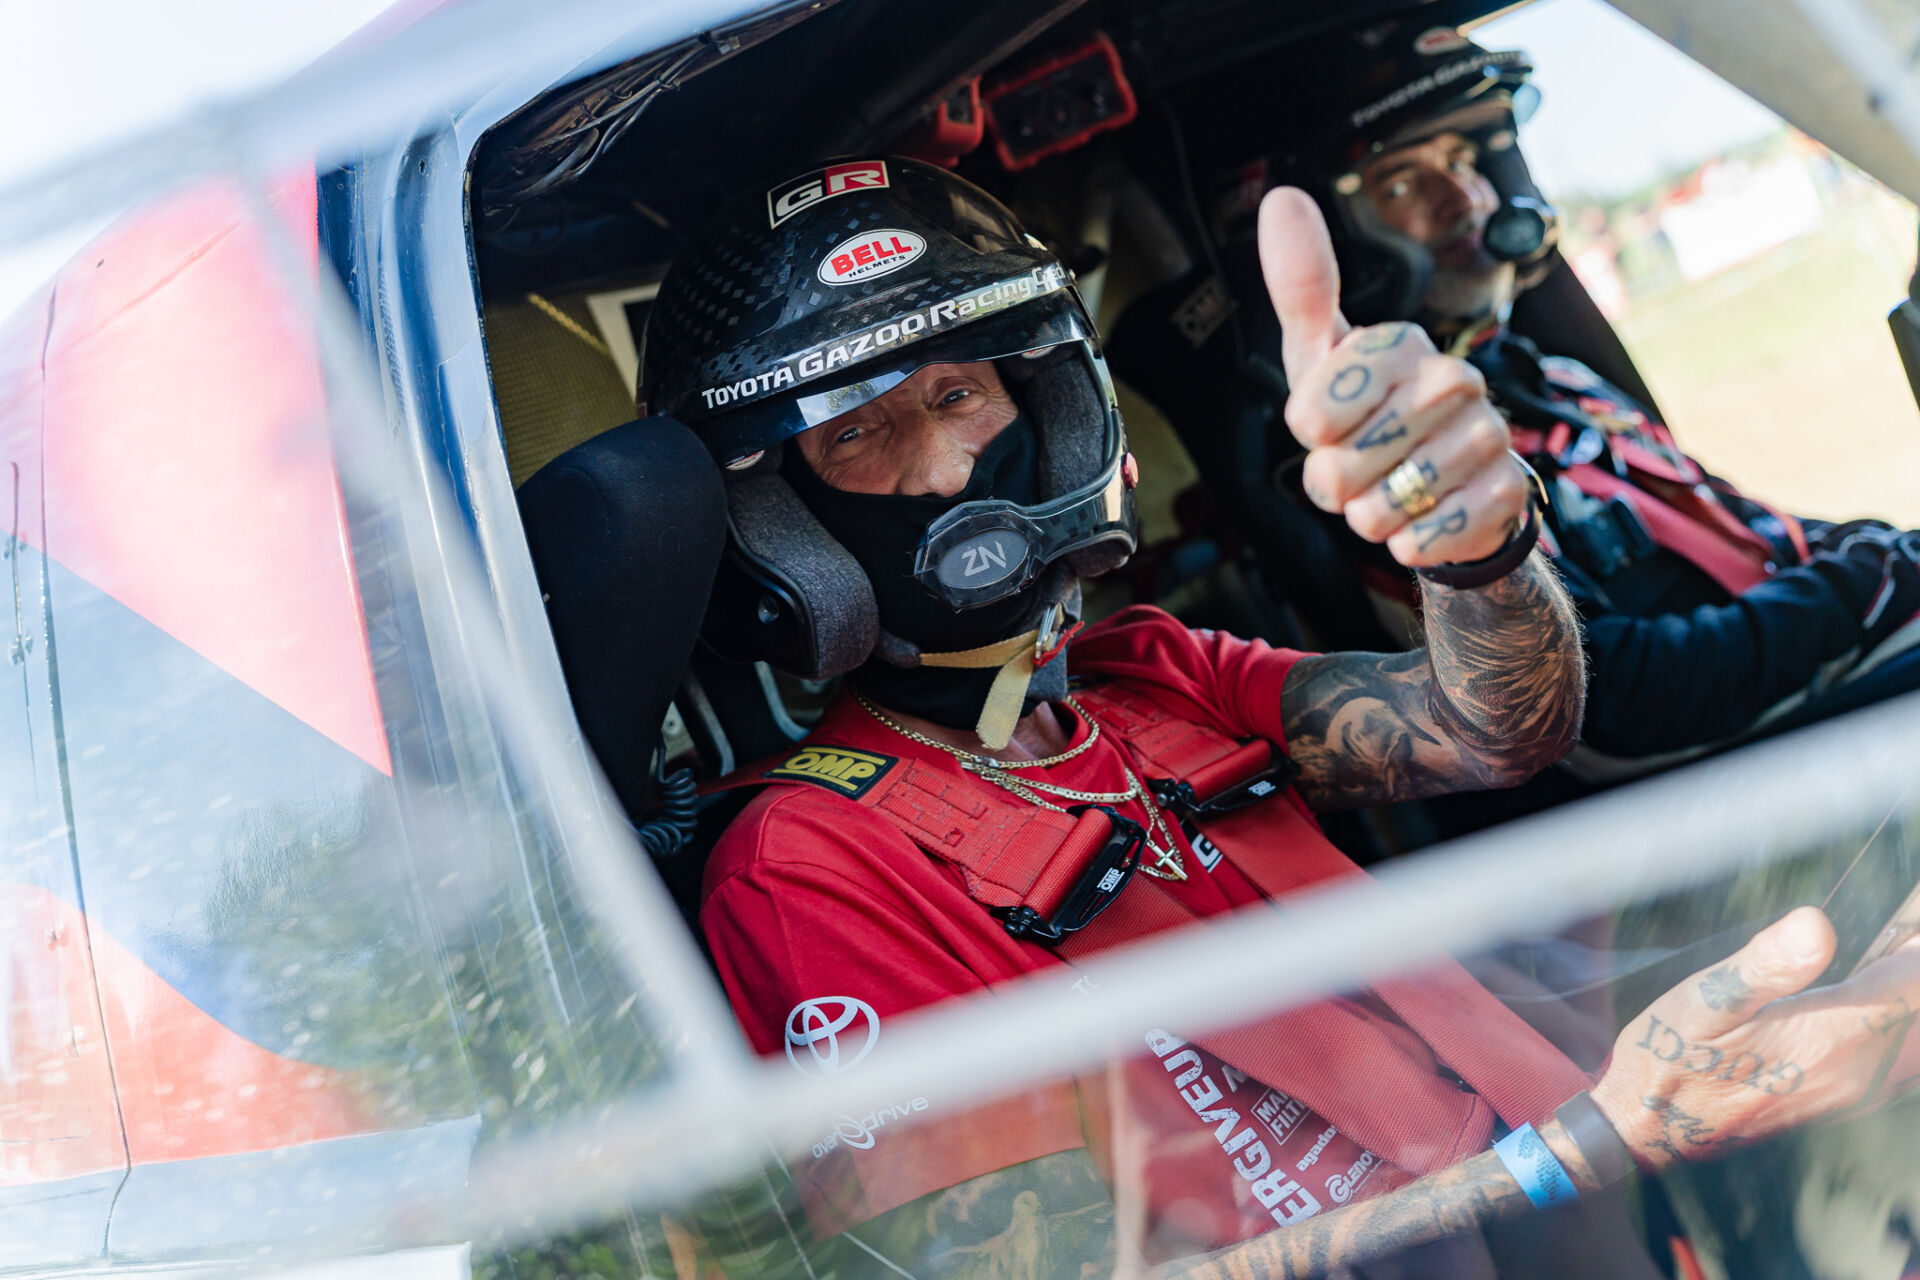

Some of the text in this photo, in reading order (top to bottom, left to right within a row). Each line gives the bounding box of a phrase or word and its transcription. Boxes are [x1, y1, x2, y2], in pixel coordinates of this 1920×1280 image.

[775, 169, 882, 217] GR
[831, 236, 912, 276] BELL
[848, 255, 906, 278] HELMETS
[702, 366, 795, 409] TOYOTA
[799, 313, 925, 378] GAZOO
[930, 277, 1031, 327] Racing
[785, 752, 877, 781] OMP
[1100, 868, 1122, 891] OMP
[1636, 1015, 1805, 1096] GUCCI
